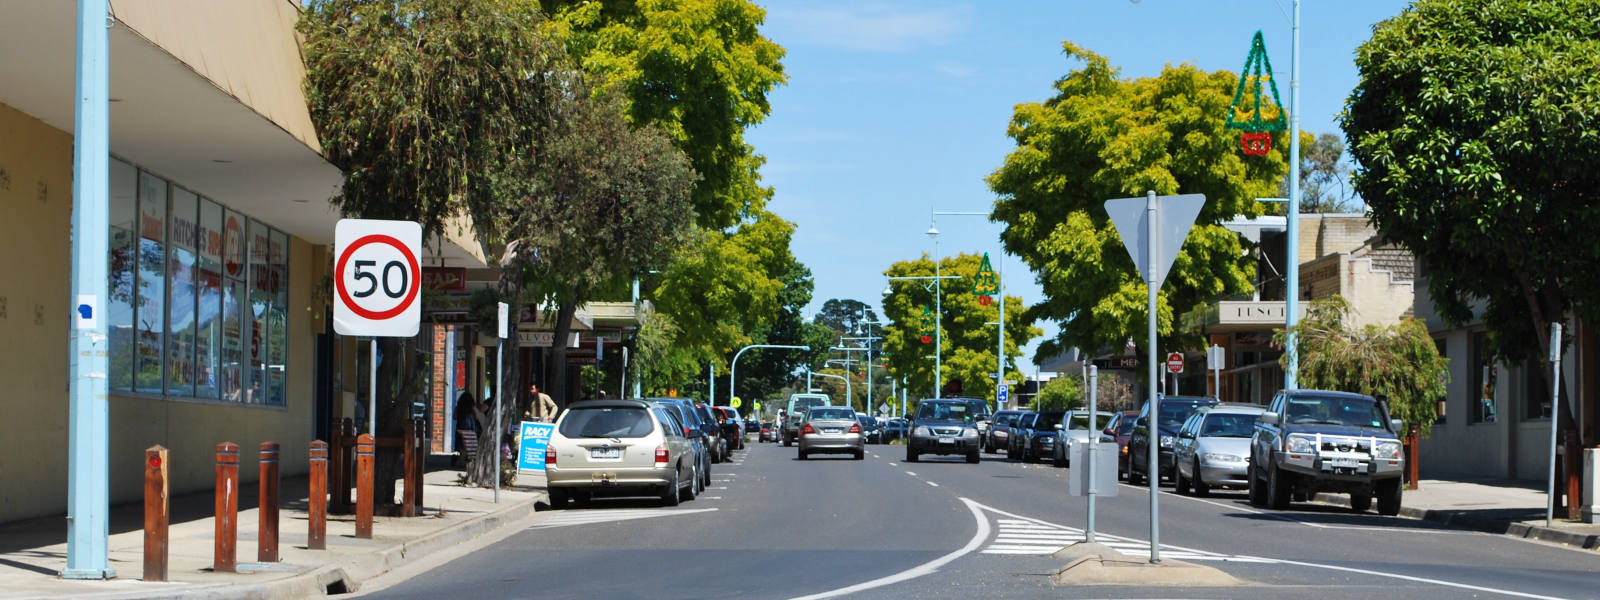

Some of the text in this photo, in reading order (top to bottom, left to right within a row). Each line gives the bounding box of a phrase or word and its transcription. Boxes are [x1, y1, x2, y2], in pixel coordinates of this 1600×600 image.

[353, 260, 408, 298] 50
[999, 386, 1007, 395] P
[524, 426, 551, 437] RACV
